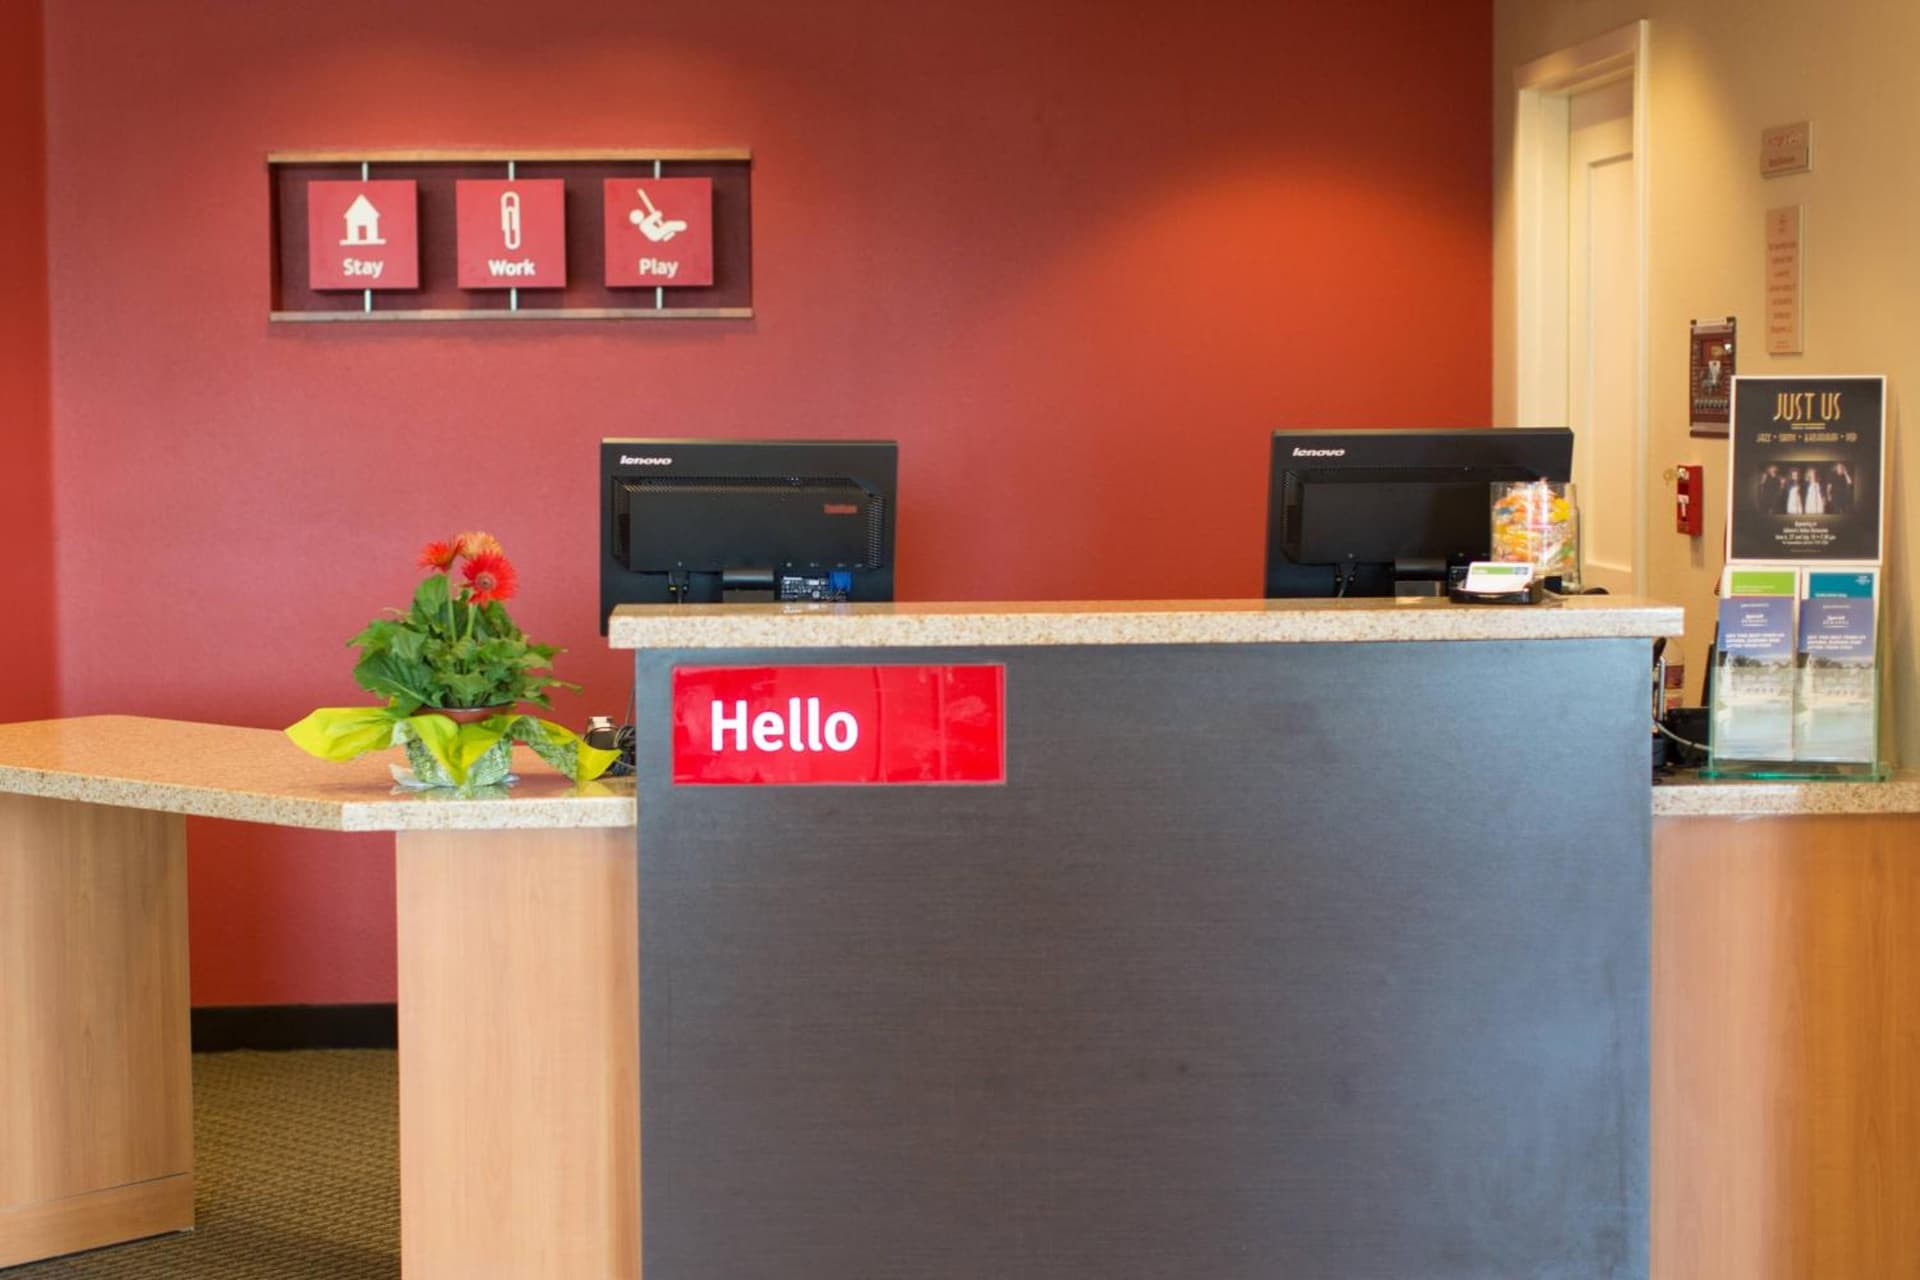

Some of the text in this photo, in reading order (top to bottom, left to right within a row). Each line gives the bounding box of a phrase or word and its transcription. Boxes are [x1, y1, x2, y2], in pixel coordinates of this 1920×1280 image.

[343, 258, 384, 279] Stay
[488, 259, 536, 277] Work
[639, 258, 679, 279] Play
[1773, 392, 1842, 422] JUST US
[619, 455, 673, 466] lenovo
[1292, 447, 1346, 457] lenovo
[711, 697, 859, 752] Hello
